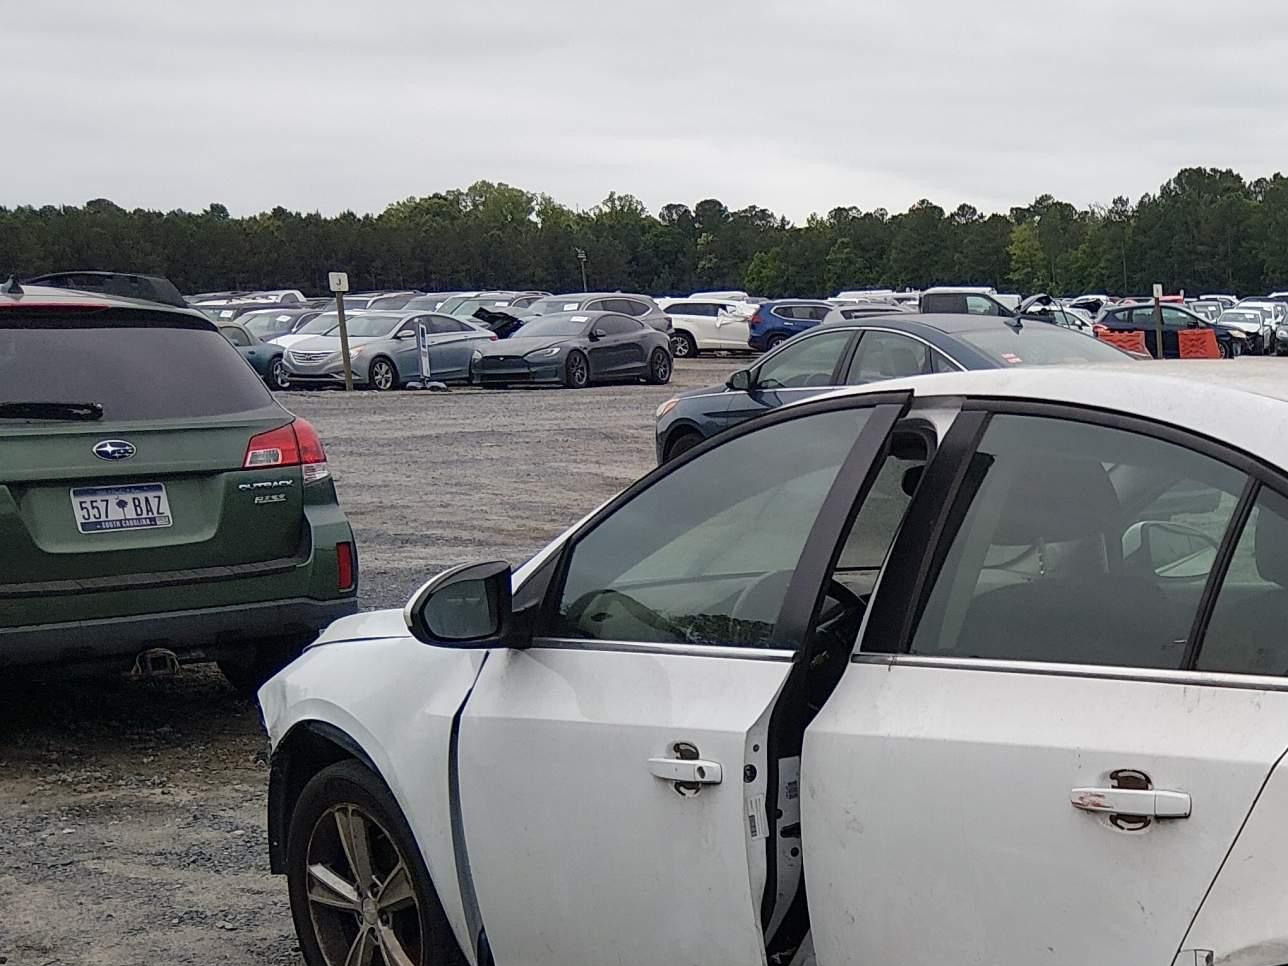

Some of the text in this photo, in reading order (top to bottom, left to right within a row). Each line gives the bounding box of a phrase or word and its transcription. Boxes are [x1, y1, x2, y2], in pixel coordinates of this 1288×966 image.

[335, 278, 342, 286] J
[238, 479, 294, 491] OUTBACK
[79, 495, 165, 521] 557 BAZ
[101, 521, 120, 529] SOUTH
[122, 518, 151, 528] CAROLINA
